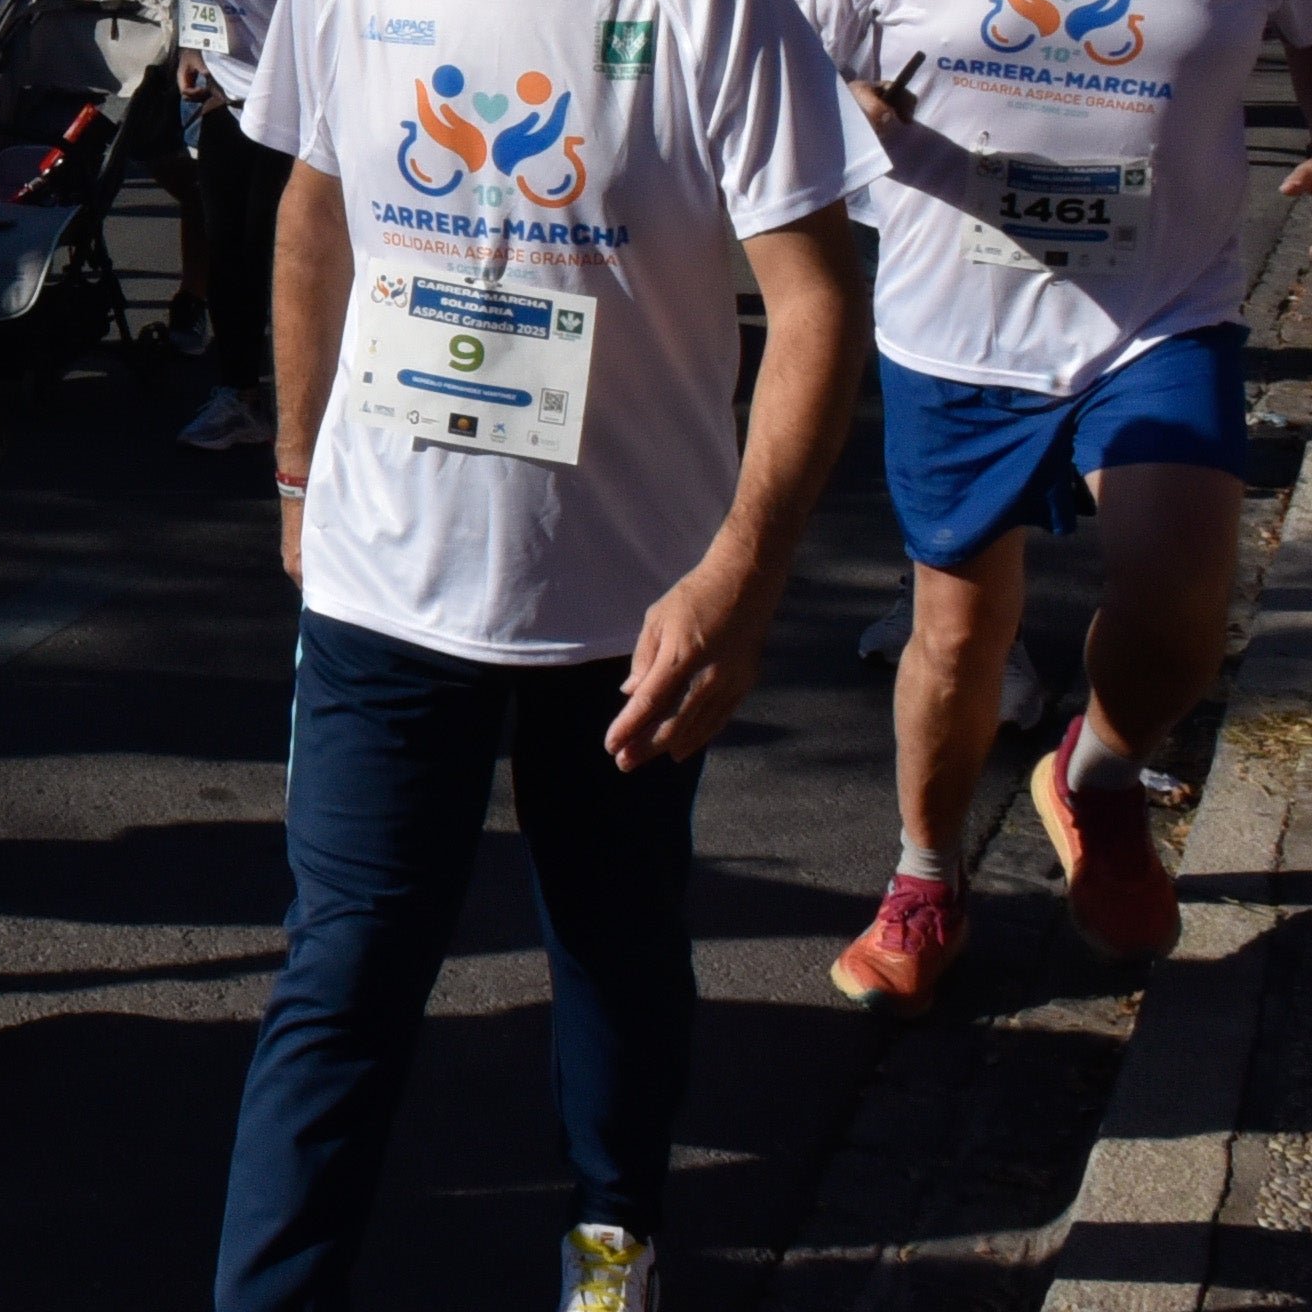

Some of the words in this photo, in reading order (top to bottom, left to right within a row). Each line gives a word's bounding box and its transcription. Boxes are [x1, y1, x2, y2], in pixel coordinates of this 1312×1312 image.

[192, 4, 218, 23] 748
[385, 18, 436, 35] ASPACE
[937, 56, 1173, 100] CARRERA-MARCHA
[952, 75, 1022, 97] SOLIDARIA
[1026, 88, 1082, 105] ASPACE
[1086, 96, 1156, 114] GRANADA
[999, 192, 1112, 225] 1461
[382, 231, 461, 259] SOLIDARIA
[464, 245, 525, 264] ASPACE
[529, 251, 619, 268] GRANADA
[416, 279, 548, 311] CARRERA-MARCHA
[440, 297, 514, 318] SOLIDARIA
[412, 305, 459, 323] ASPACE
[462, 315, 515, 333] Granada
[516, 325, 547, 338] 2025
[448, 333, 486, 373] 9
